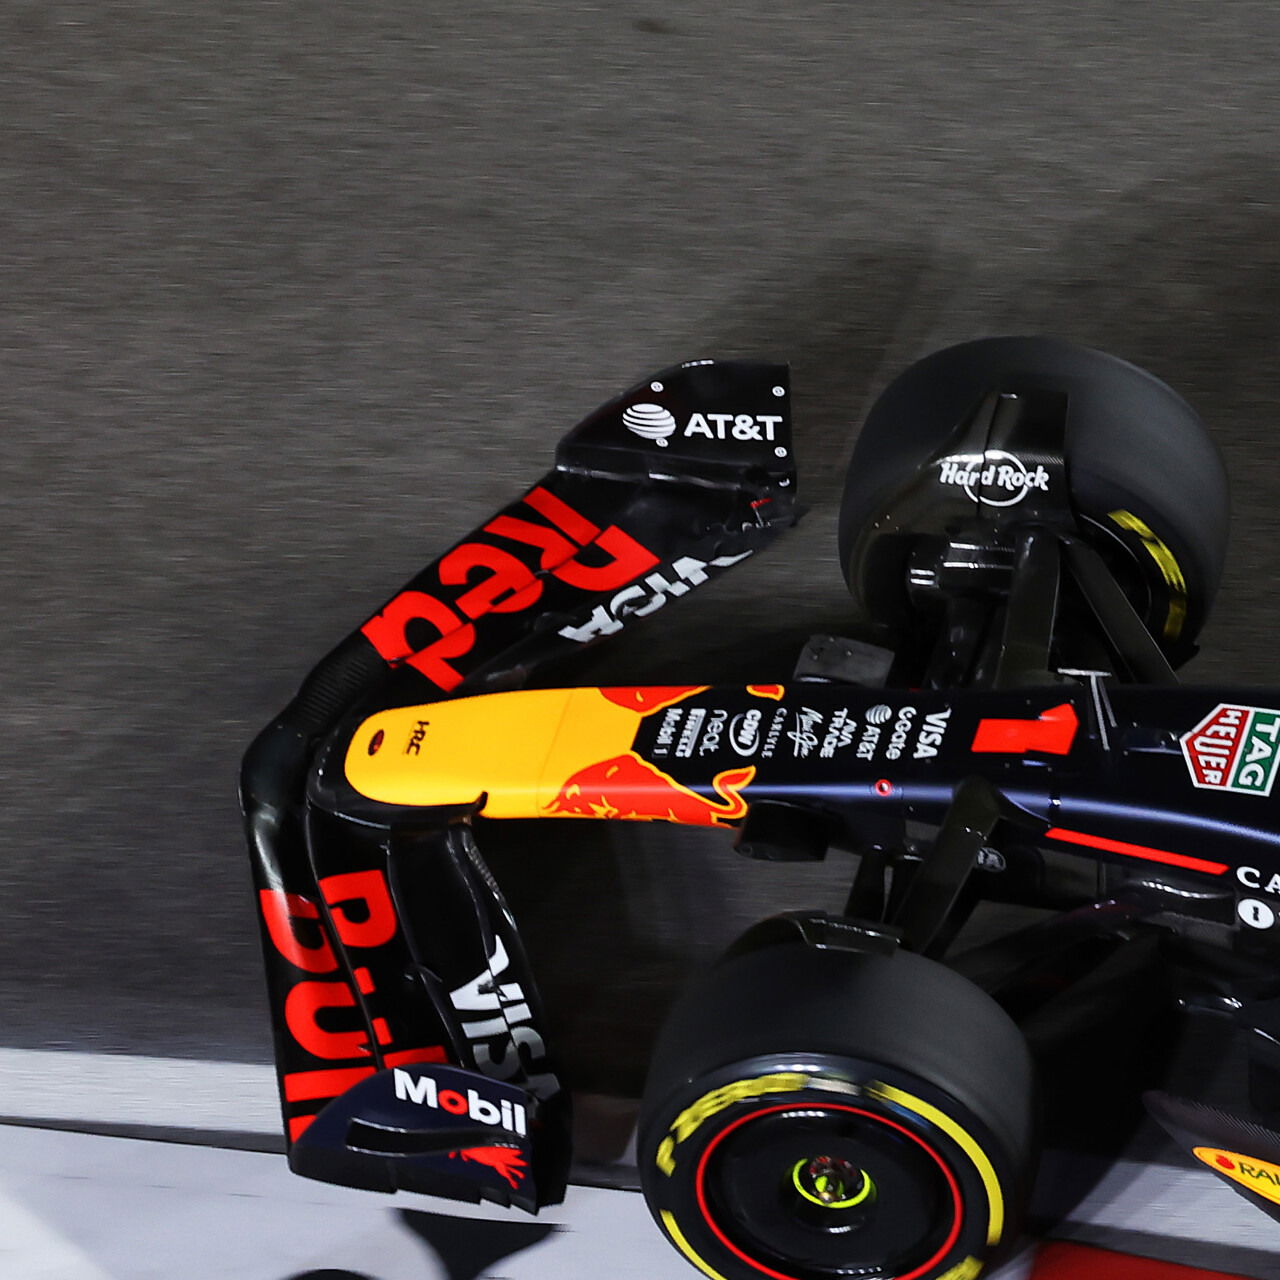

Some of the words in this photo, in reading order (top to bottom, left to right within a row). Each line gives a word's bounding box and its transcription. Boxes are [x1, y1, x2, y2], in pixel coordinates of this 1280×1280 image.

[684, 412, 783, 441] AT&T
[939, 462, 992, 487] Hard
[995, 464, 1050, 491] Rock
[361, 486, 660, 693] Red
[406, 720, 430, 755] HRC
[738, 709, 762, 746] CDW
[761, 707, 788, 759] CARLYLE
[913, 707, 952, 759] VISA
[1193, 709, 1242, 785] HEUER
[393, 1067, 527, 1137] Mobil
